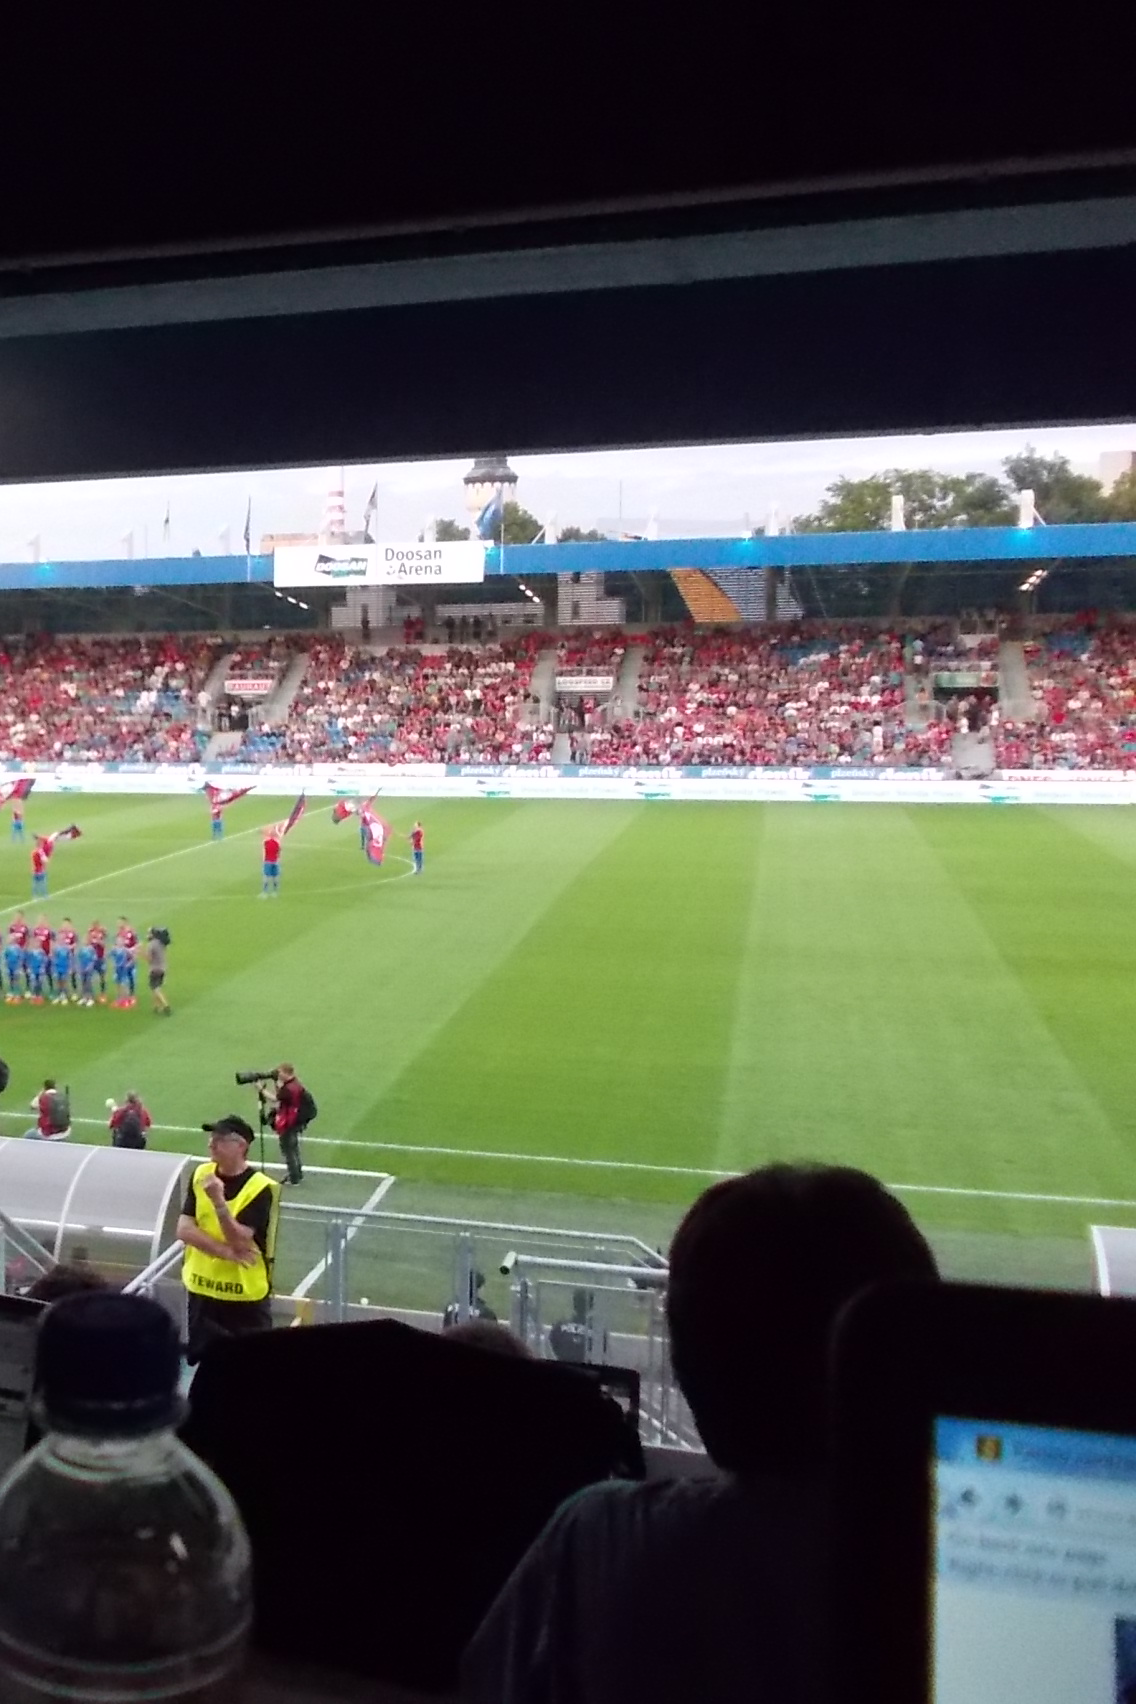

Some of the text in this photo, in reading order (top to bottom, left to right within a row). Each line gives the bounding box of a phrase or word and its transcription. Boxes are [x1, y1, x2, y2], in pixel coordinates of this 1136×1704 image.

[385, 547, 442, 562] Doosan
[315, 559, 367, 573] DOOSAN
[397, 562, 442, 576] Arena
[191, 1273, 244, 1295] TEWARD
